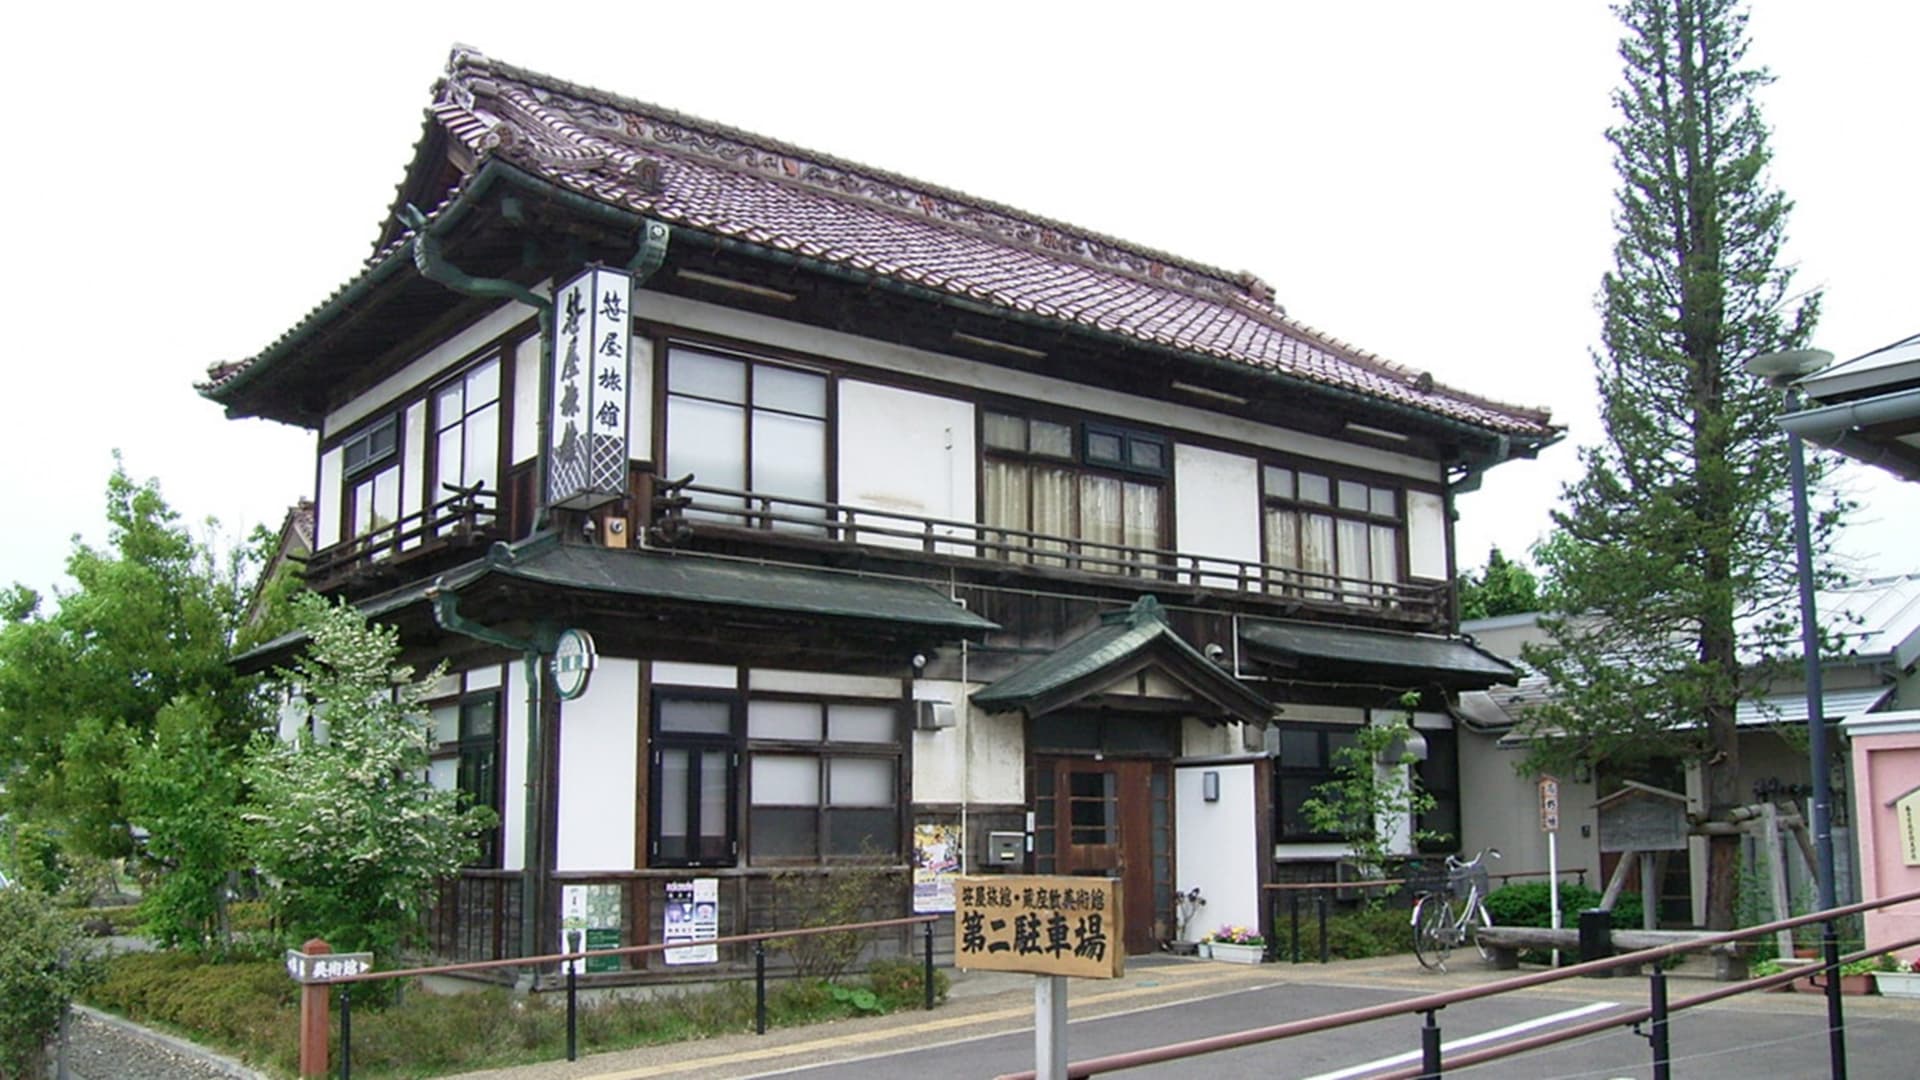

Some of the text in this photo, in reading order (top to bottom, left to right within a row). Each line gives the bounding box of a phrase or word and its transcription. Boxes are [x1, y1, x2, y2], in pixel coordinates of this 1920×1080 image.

[597, 291, 626, 429] 笹屋旅館
[962, 910, 1106, 963] 第二駐車場
